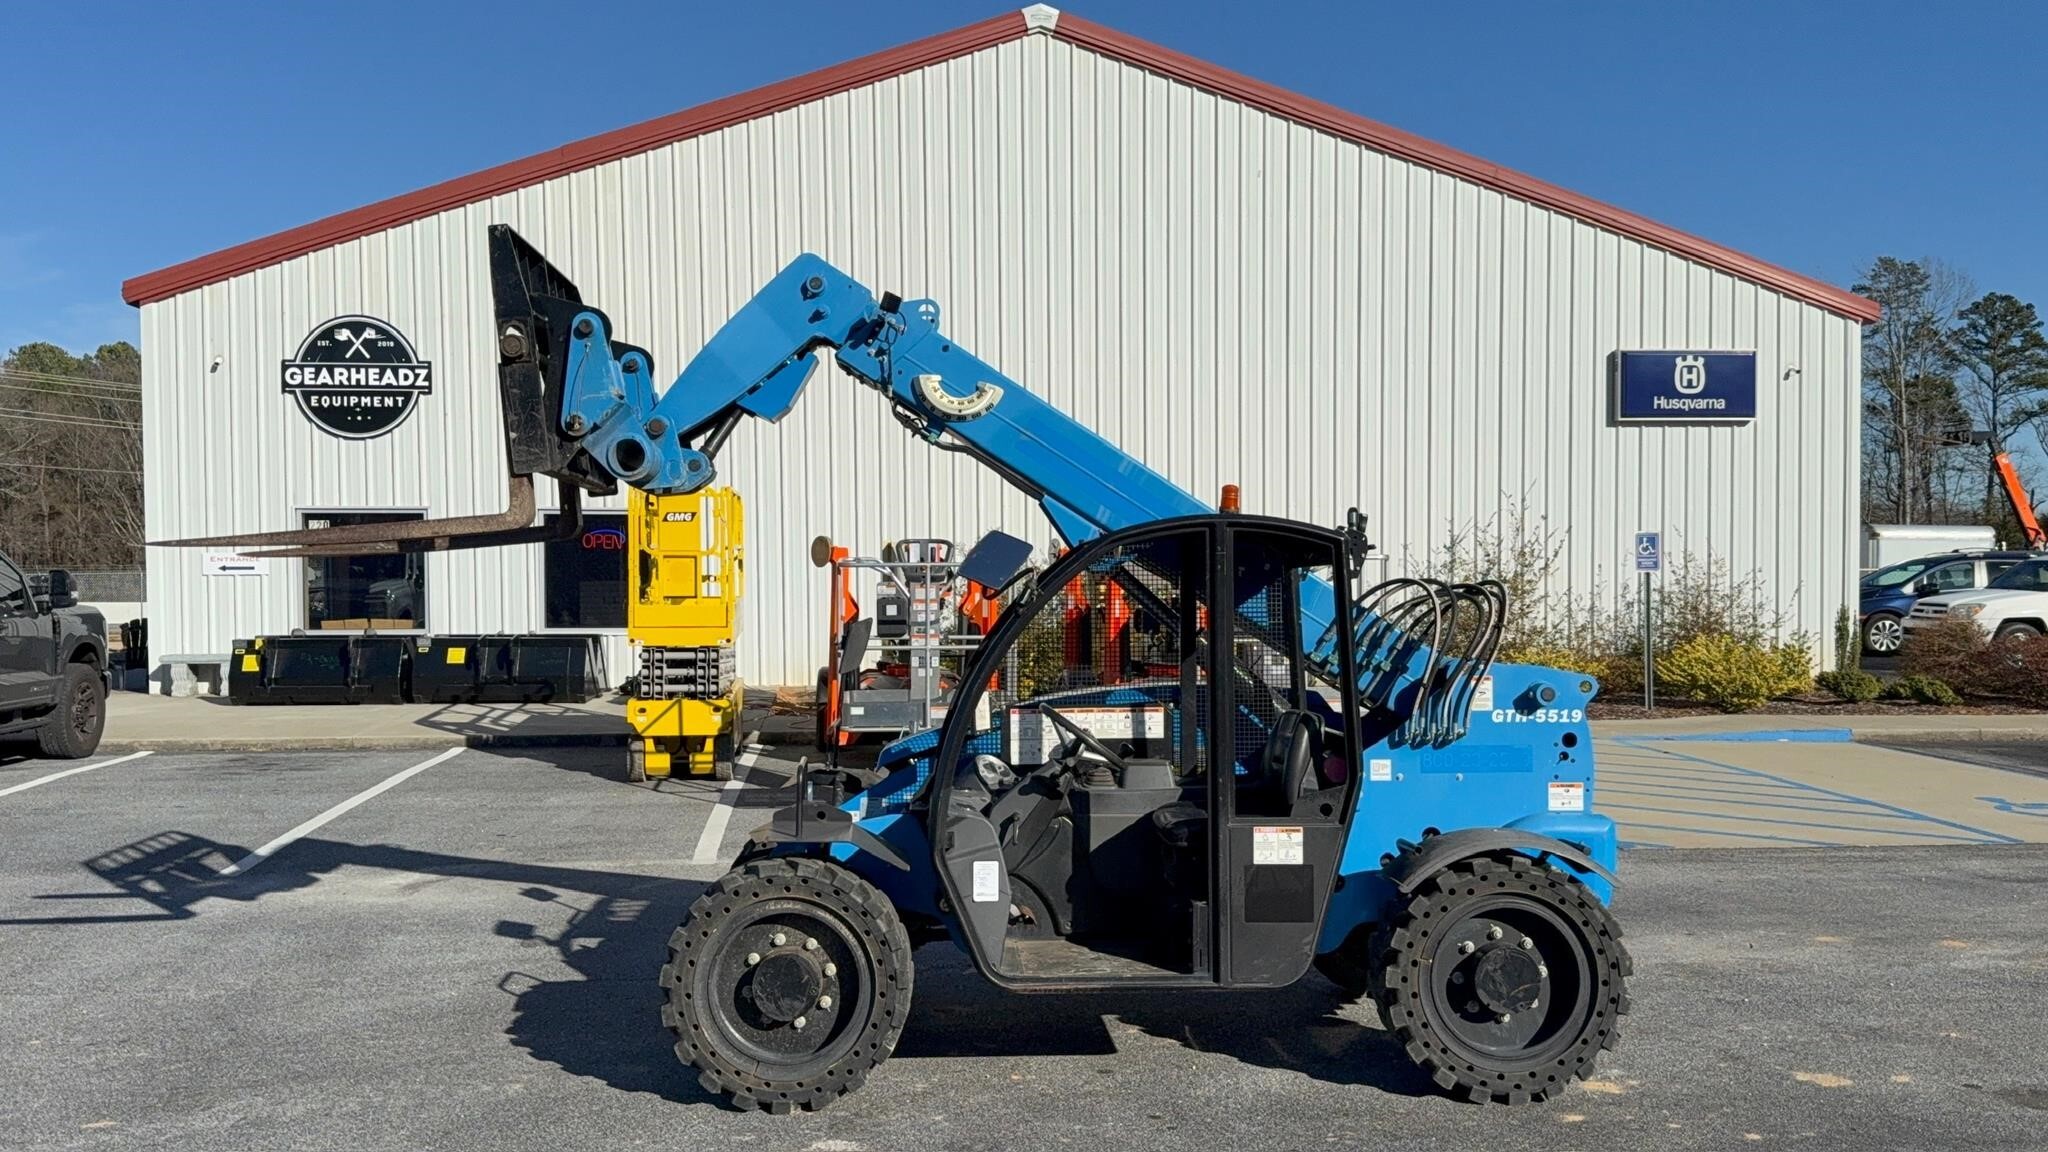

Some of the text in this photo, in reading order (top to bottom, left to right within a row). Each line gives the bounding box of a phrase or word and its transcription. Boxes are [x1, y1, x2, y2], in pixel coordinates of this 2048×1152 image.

[284, 367, 430, 387] GEARHEADZ
[310, 395, 405, 408] EQUIPMENT
[1653, 396, 1726, 412] Husqvarna
[666, 512, 693, 521] GMG
[582, 533, 622, 549] OPEN
[1491, 709, 1583, 723] GTH-5519
